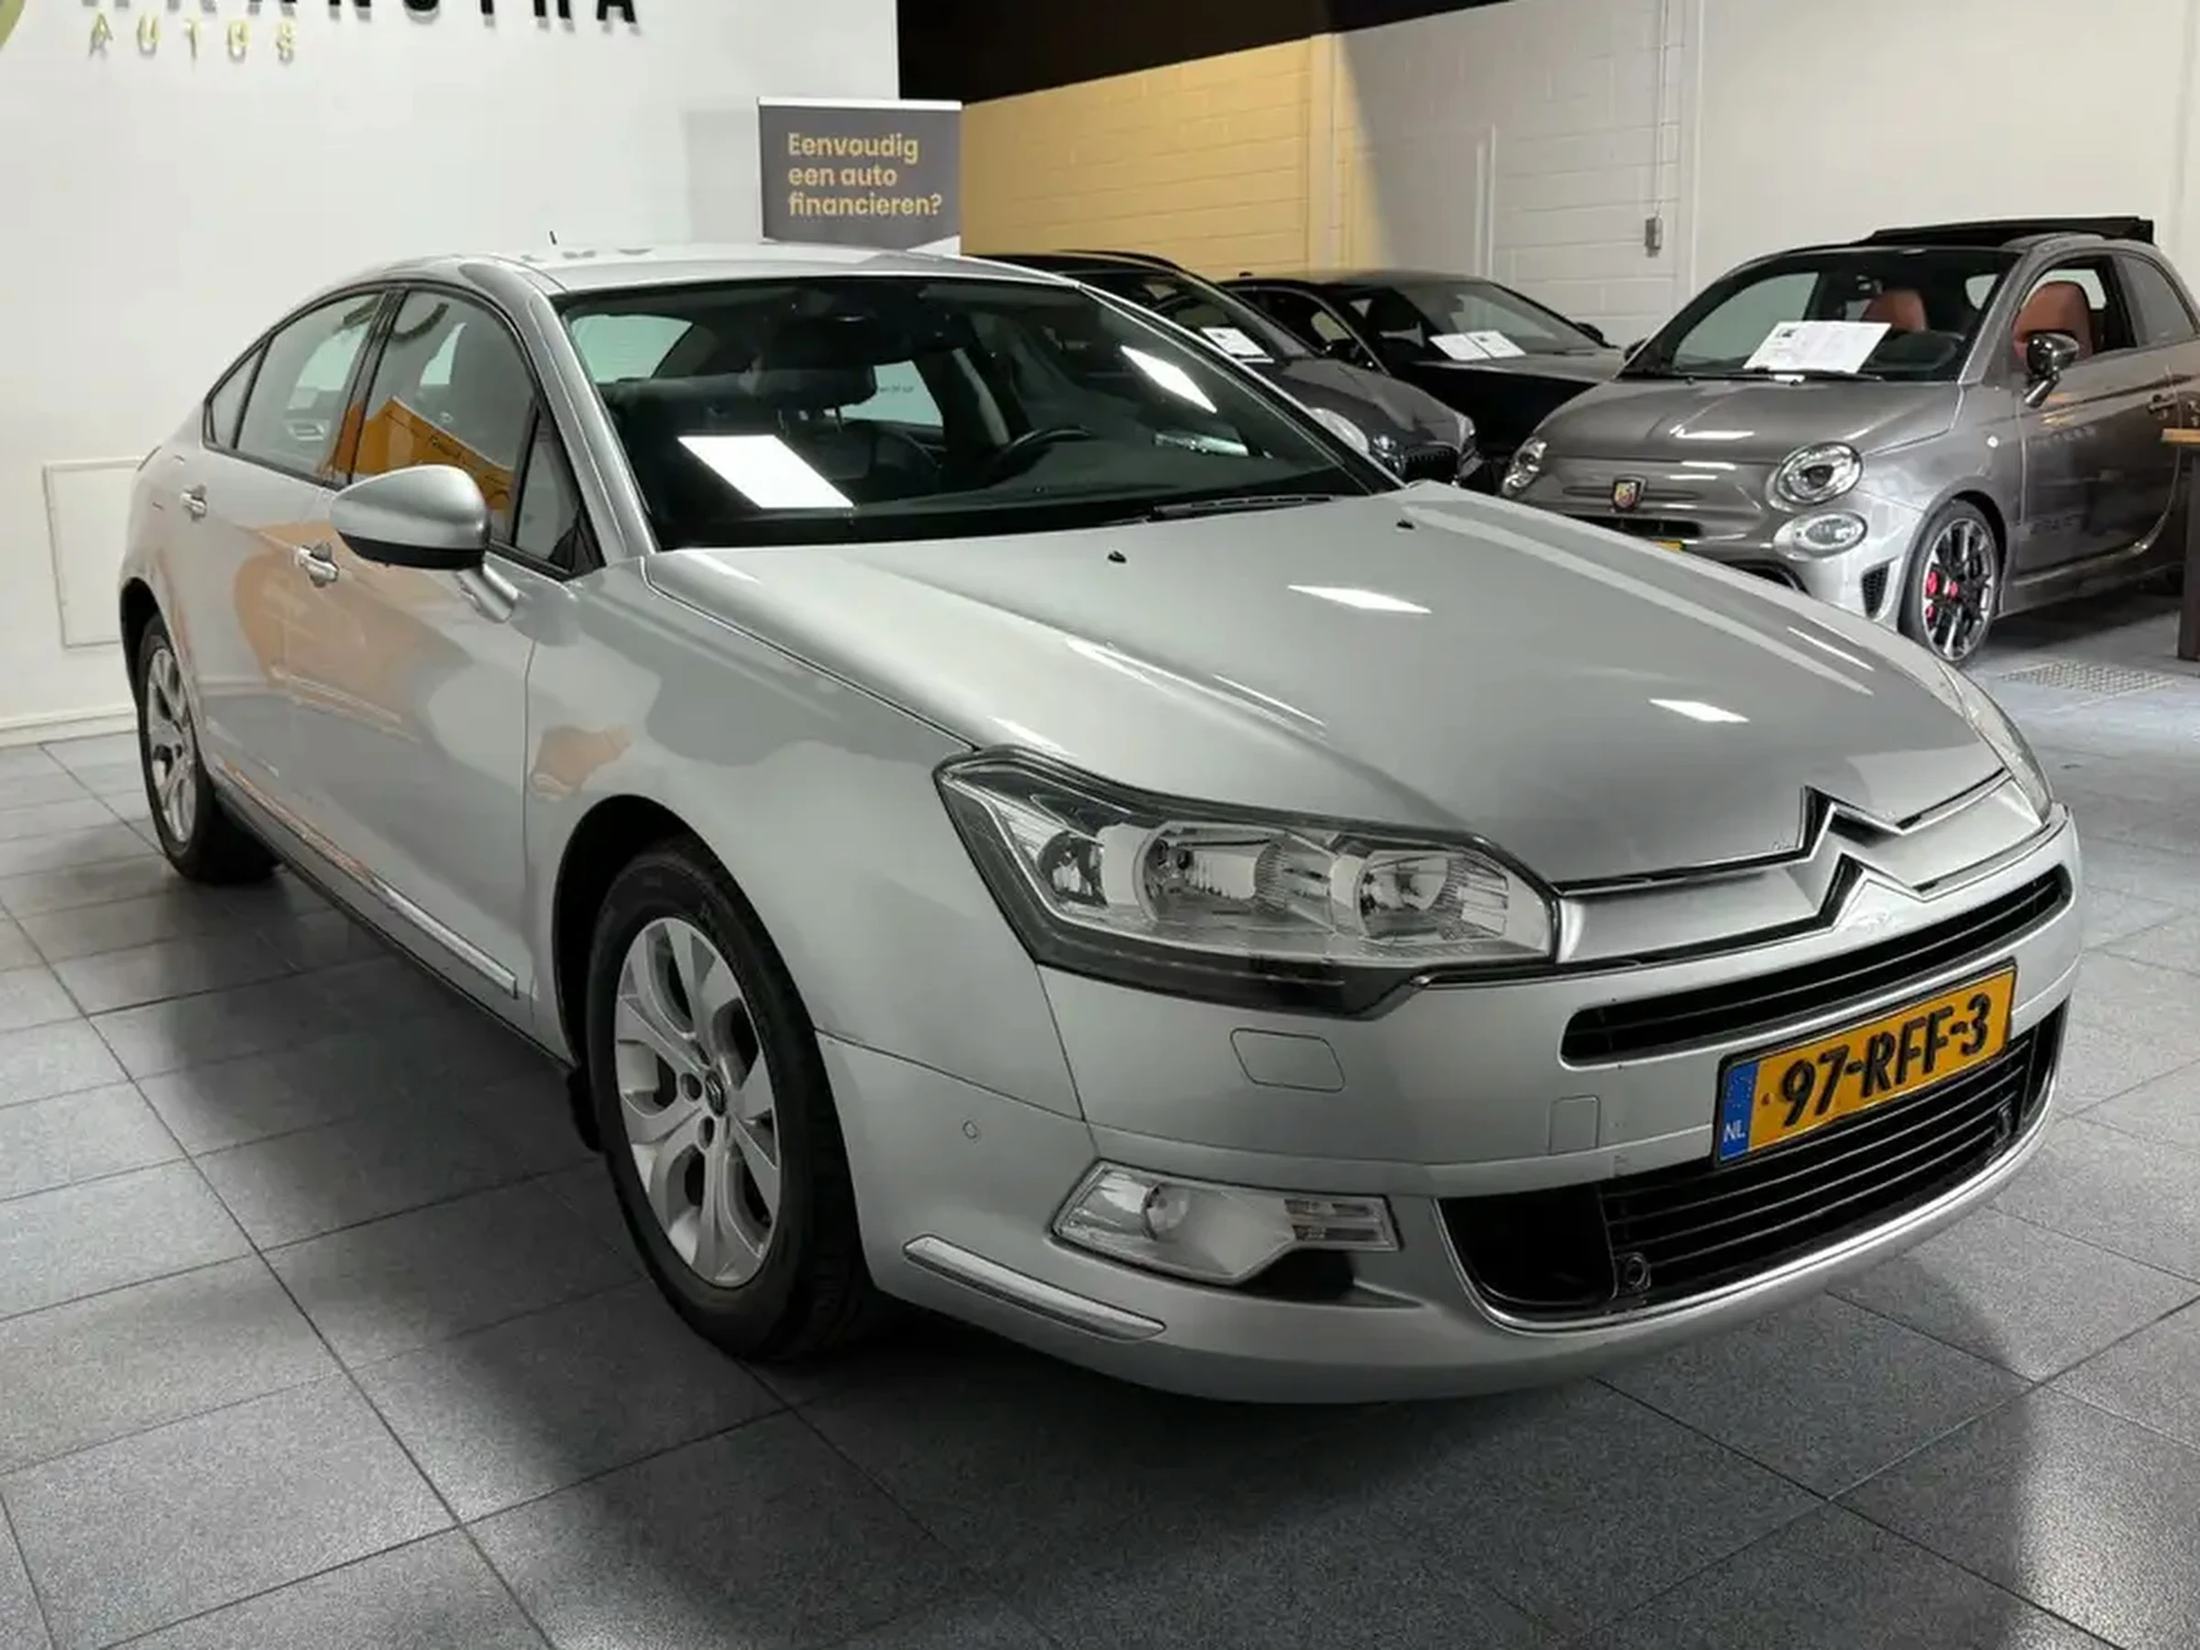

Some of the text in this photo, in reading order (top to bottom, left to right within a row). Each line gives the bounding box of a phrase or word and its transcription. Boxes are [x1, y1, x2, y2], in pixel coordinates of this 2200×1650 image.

[88, 13, 296, 64] AUTOS
[787, 132, 919, 164] Eenvoudig
[788, 164, 898, 187] een auto
[788, 191, 943, 216] financieren?
[1781, 993, 1992, 1128] 97-RFF-3
[1723, 1119, 1747, 1143] NL
